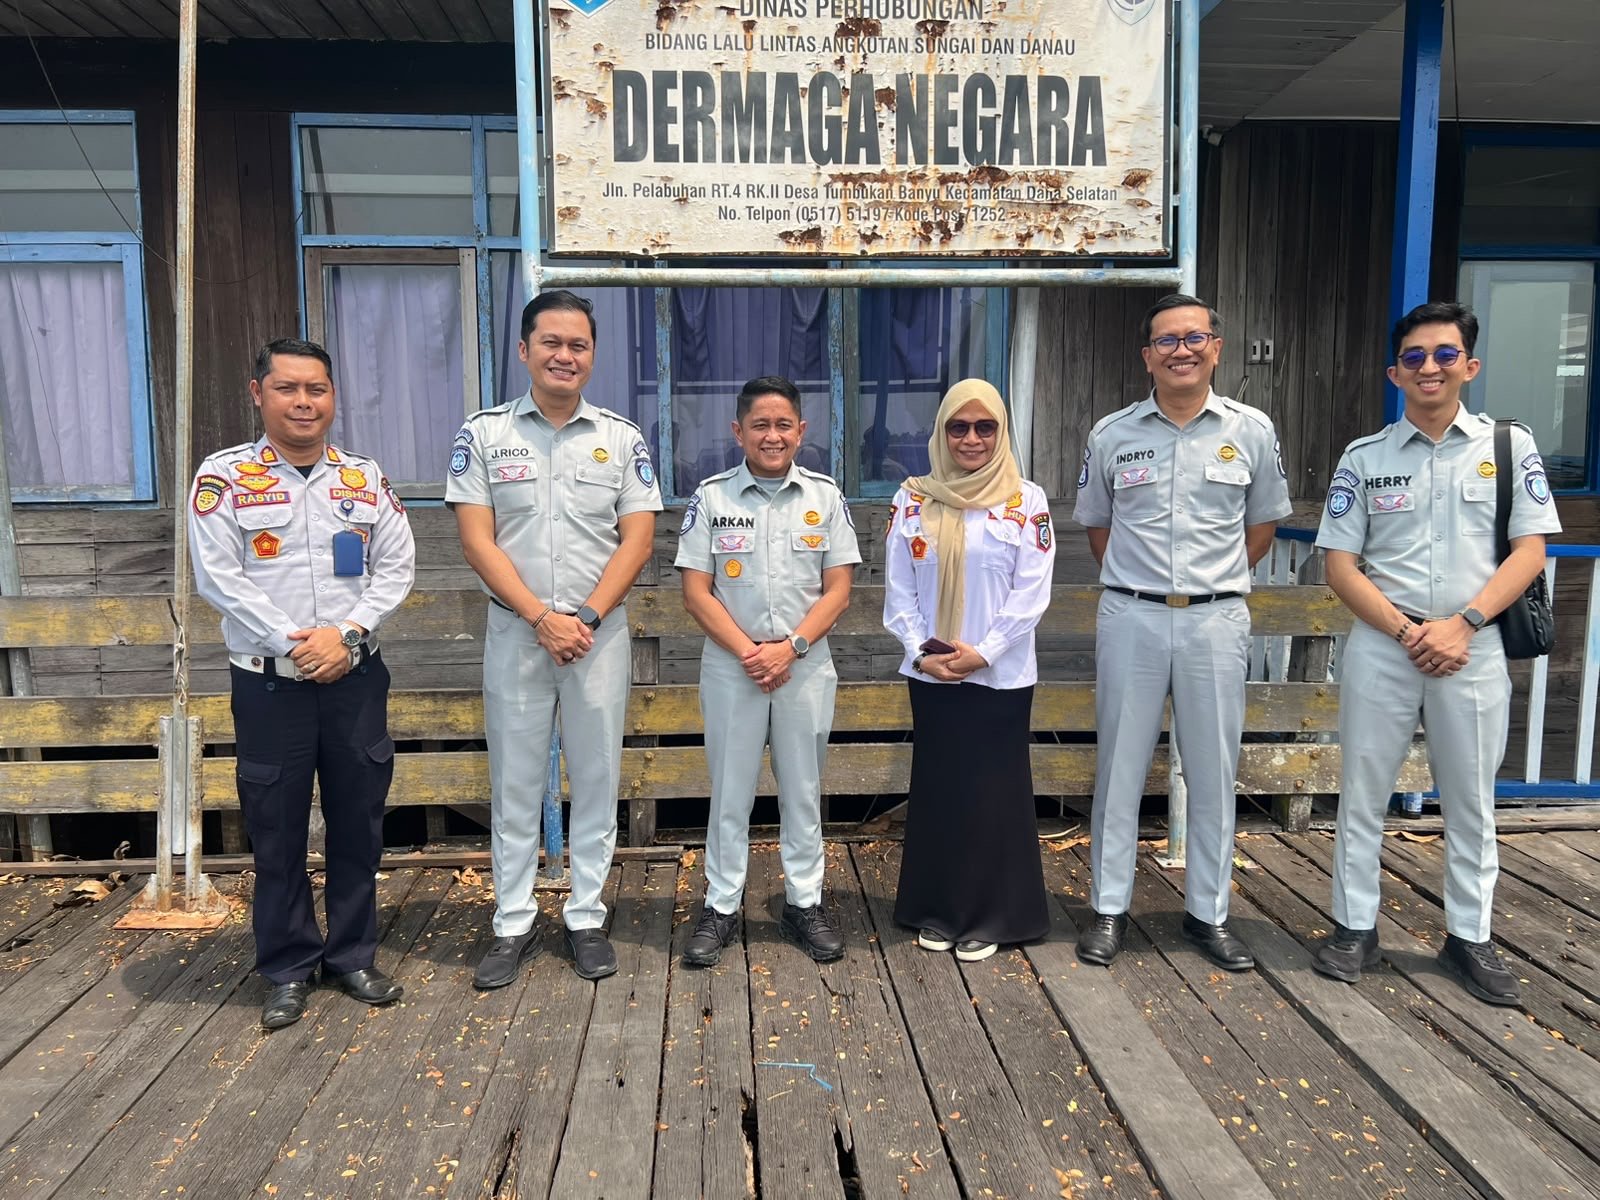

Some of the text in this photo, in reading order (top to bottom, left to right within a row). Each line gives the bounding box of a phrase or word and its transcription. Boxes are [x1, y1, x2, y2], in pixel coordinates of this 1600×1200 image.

[739, 0, 984, 21] DINAS PERHUBUNGAN
[645, 33, 1076, 56] BIDANG LALU LINTAS ANGKUTAN SUNGAI DAN DANAU
[612, 69, 1108, 168] DERMAGA NEGARA
[602, 182, 628, 199] Jln.
[633, 182, 706, 200] Pelabuhan
[711, 183, 741, 199] RT.4
[746, 184, 779, 200] RK.II
[784, 184, 819, 200] Desa
[898, 185, 940, 203] Banyu
[945, 185, 1022, 201] Kecamatan
[1067, 185, 1118, 201] Selatan
[718, 206, 741, 221] No.
[745, 207, 791, 224] Telpon
[796, 206, 842, 224] (0517)
[895, 207, 929, 221] Kode
[964, 207, 1006, 222] 71252
[491, 448, 529, 459] J.RICO
[1116, 450, 1155, 465] INDRYO
[1365, 475, 1412, 490] HERRY
[237, 492, 286, 505] RASYID
[332, 489, 376, 502] DISHUB
[711, 516, 755, 529] ARKAN
